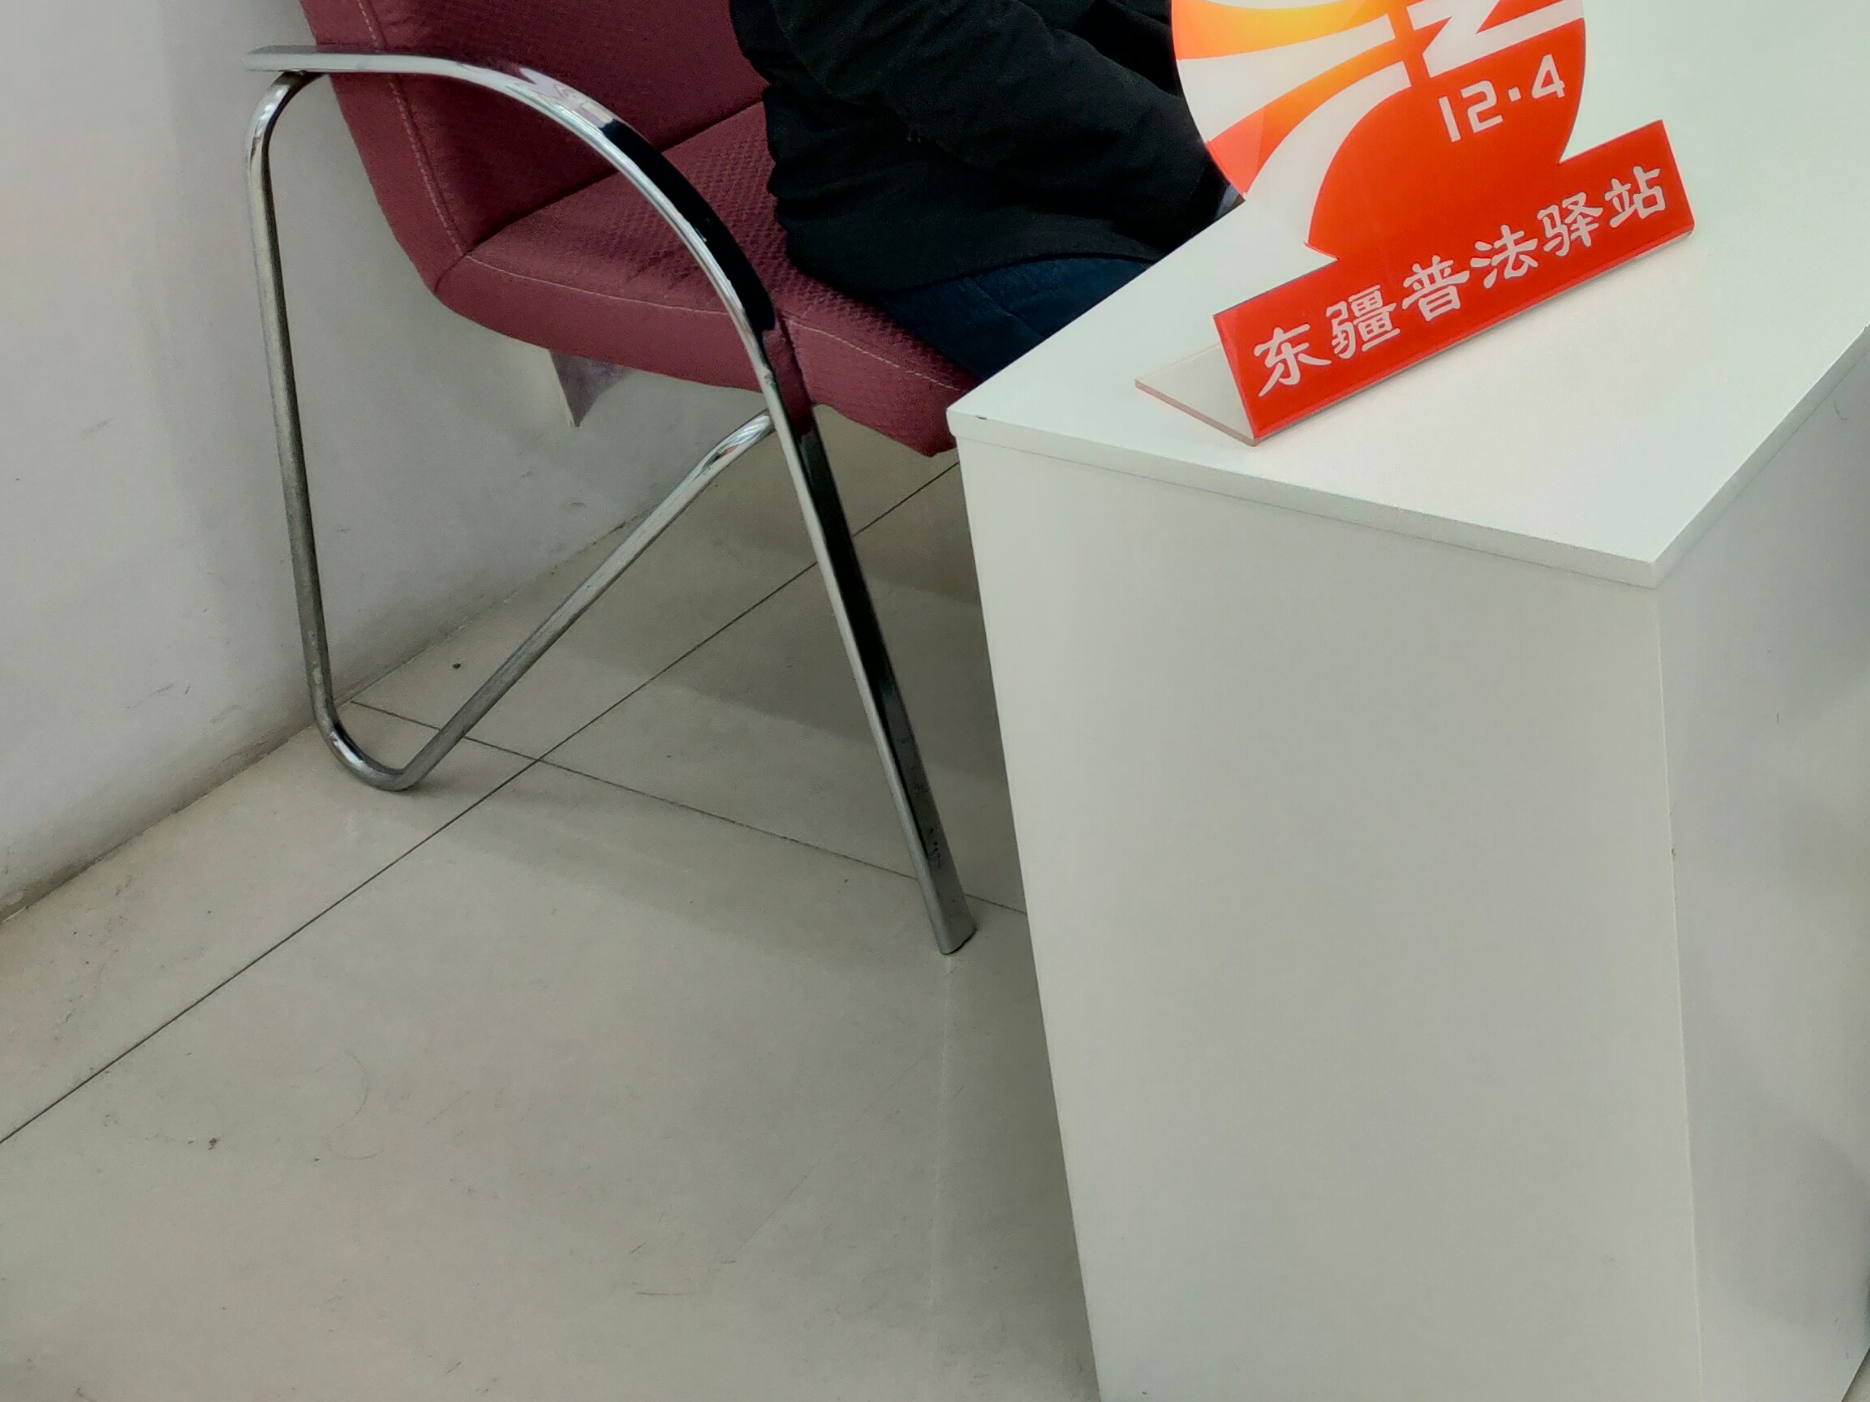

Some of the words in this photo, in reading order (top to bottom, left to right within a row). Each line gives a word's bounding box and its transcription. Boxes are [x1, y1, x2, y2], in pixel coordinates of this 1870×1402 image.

[1252, 165, 1666, 398] 东疆普法驿站
